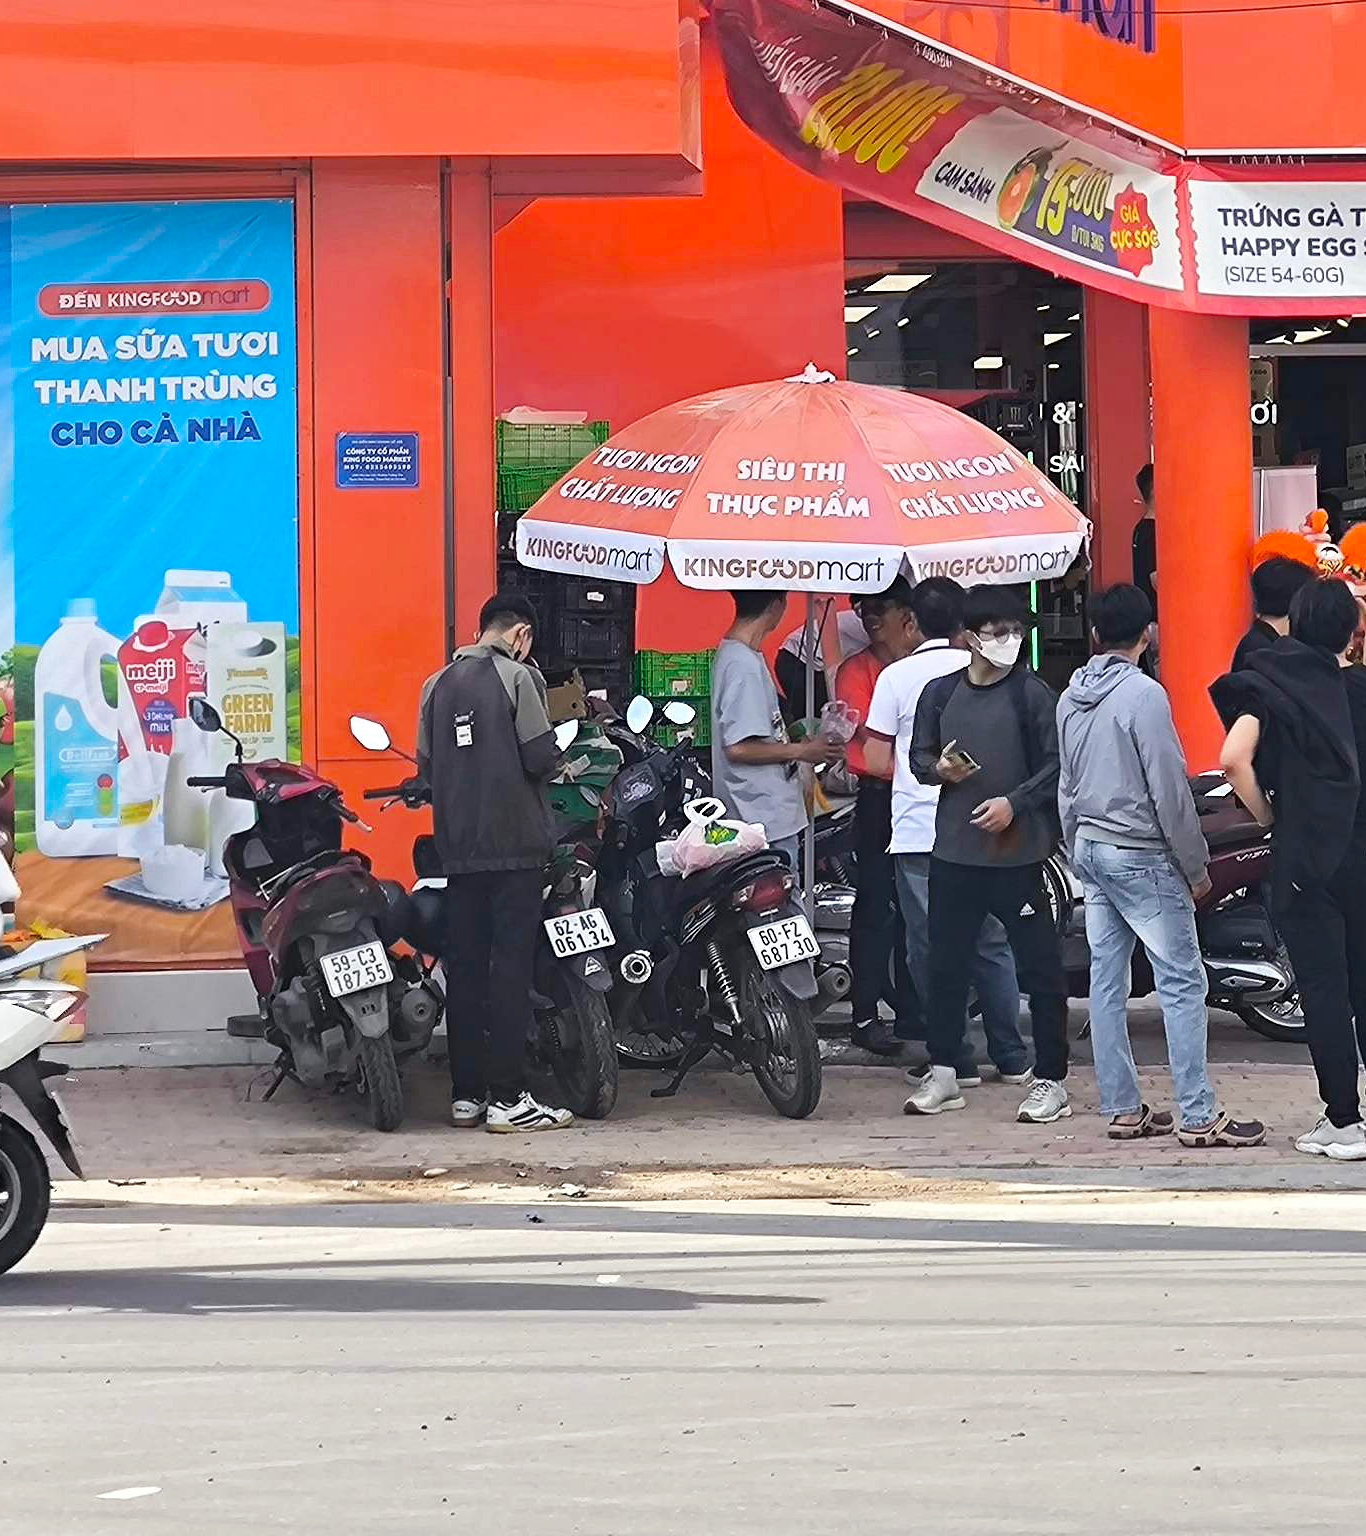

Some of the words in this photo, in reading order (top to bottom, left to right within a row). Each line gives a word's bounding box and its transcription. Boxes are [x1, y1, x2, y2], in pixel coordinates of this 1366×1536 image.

[934, 161, 961, 191] CAM
[1120, 200, 1140, 224] GIÁ
[1217, 202, 1301, 227] TRỨNG
[1307, 202, 1344, 227] GÀ
[1111, 229, 1133, 254] CỰC
[1134, 223, 1160, 249] SỐC
[1221, 236, 1301, 257] HAPPY
[1307, 237, 1357, 257] EGG
[1224, 266, 1267, 285] (SIZE
[1271, 267, 1345, 286] 54-60G)
[59, 290, 101, 309] ĐẾN
[31, 336, 108, 363] MUA
[115, 328, 188, 361] SỮA
[192, 331, 280, 359] TƯƠI
[33, 377, 155, 406] THANH
[159, 369, 278, 402] TRÙNG
[51, 420, 123, 447] CHO
[130, 411, 180, 445] CẢ
[187, 410, 262, 443] NHÀ
[737, 456, 796, 482] SIÊU
[801, 462, 846, 485] THỊ
[884, 460, 941, 483] TƯƠI
[936, 453, 1015, 480] NGON
[560, 475, 615, 503] CHẤT
[609, 486, 683, 510] LƯỢNG
[707, 493, 779, 519] THỰC
[784, 488, 871, 518] PHẨM
[900, 489, 960, 520] CHẤT
[964, 486, 1044, 522] LƯỢNG
[126, 659, 177, 683] meiji
[221, 693, 274, 714] GREEN
[224, 713, 272, 734] FARM
[553, 913, 597, 937] 62-AG
[758, 920, 803, 948] 60-F2
[555, 927, 611, 956] 061.34
[760, 937, 815, 966] 687.30
[330, 948, 377, 975] 59-C3
[333, 964, 388, 994] 187.55
